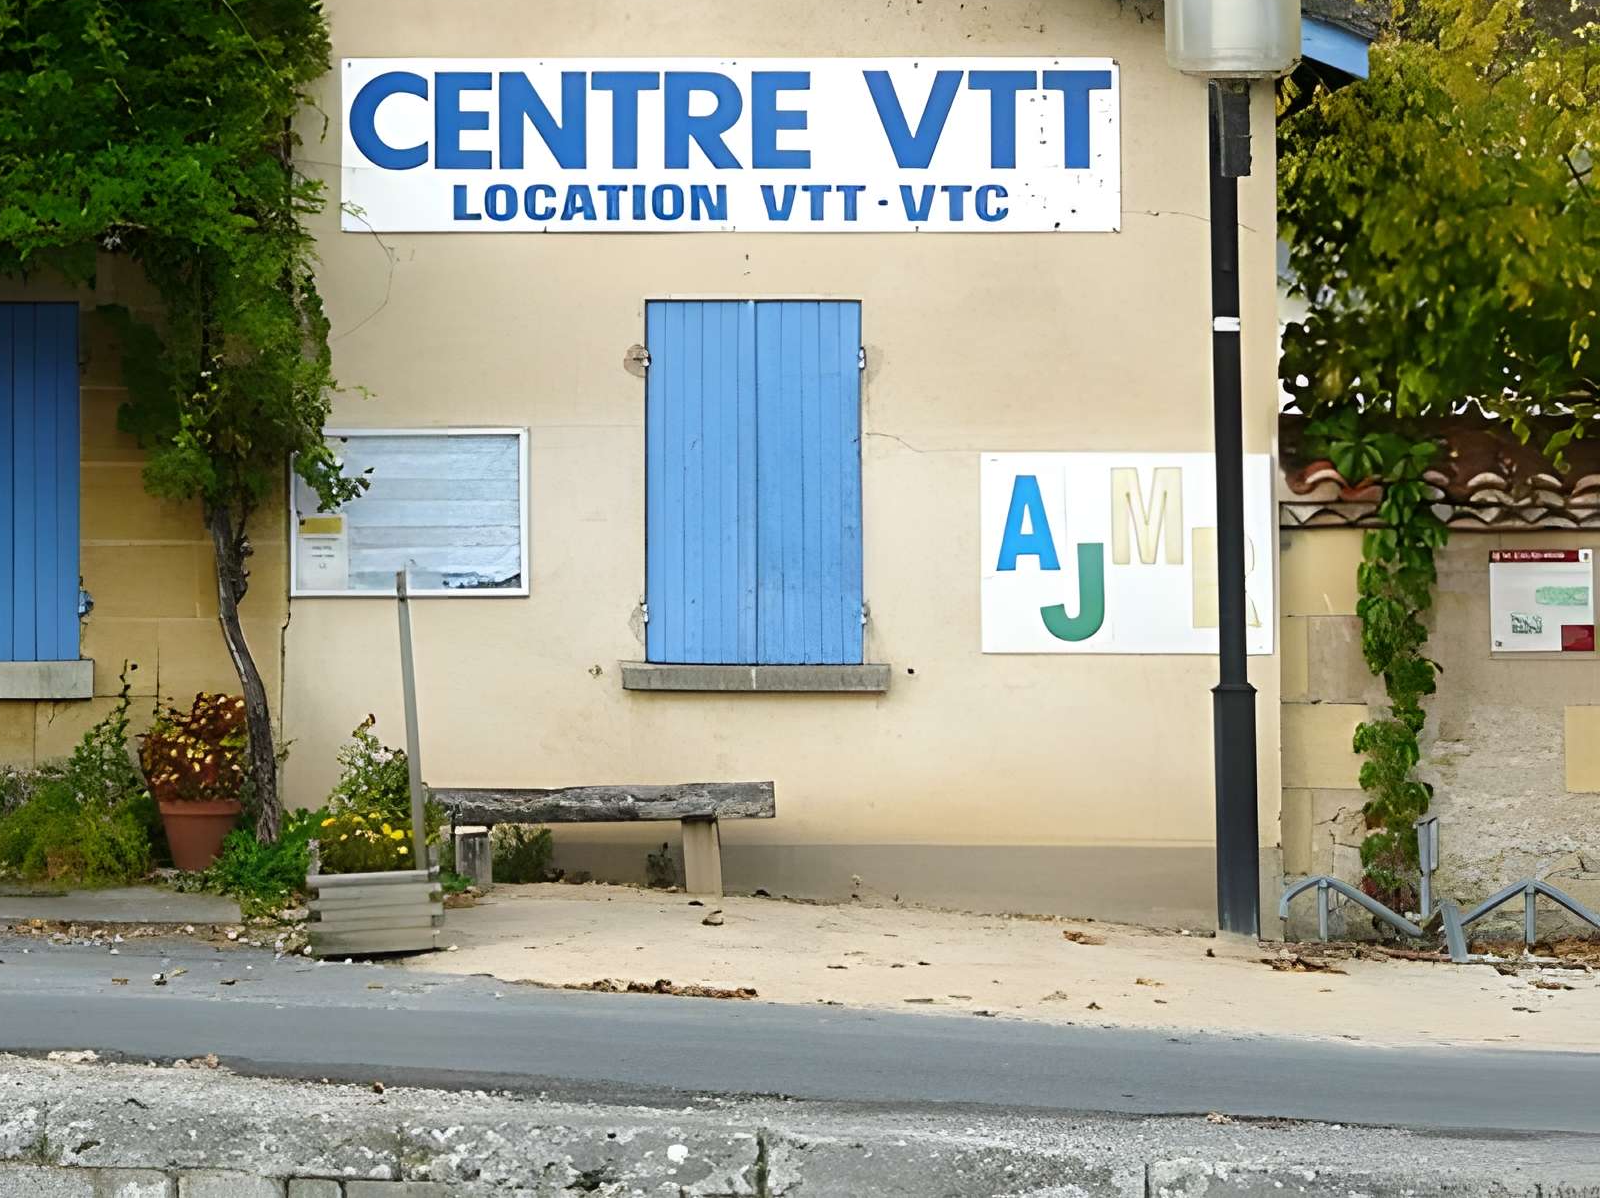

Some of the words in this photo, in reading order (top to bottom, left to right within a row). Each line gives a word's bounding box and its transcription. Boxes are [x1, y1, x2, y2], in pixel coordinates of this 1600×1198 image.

[350, 71, 811, 170] CENTRE
[863, 71, 1112, 169] VTT
[453, 184, 727, 222] LOCATION
